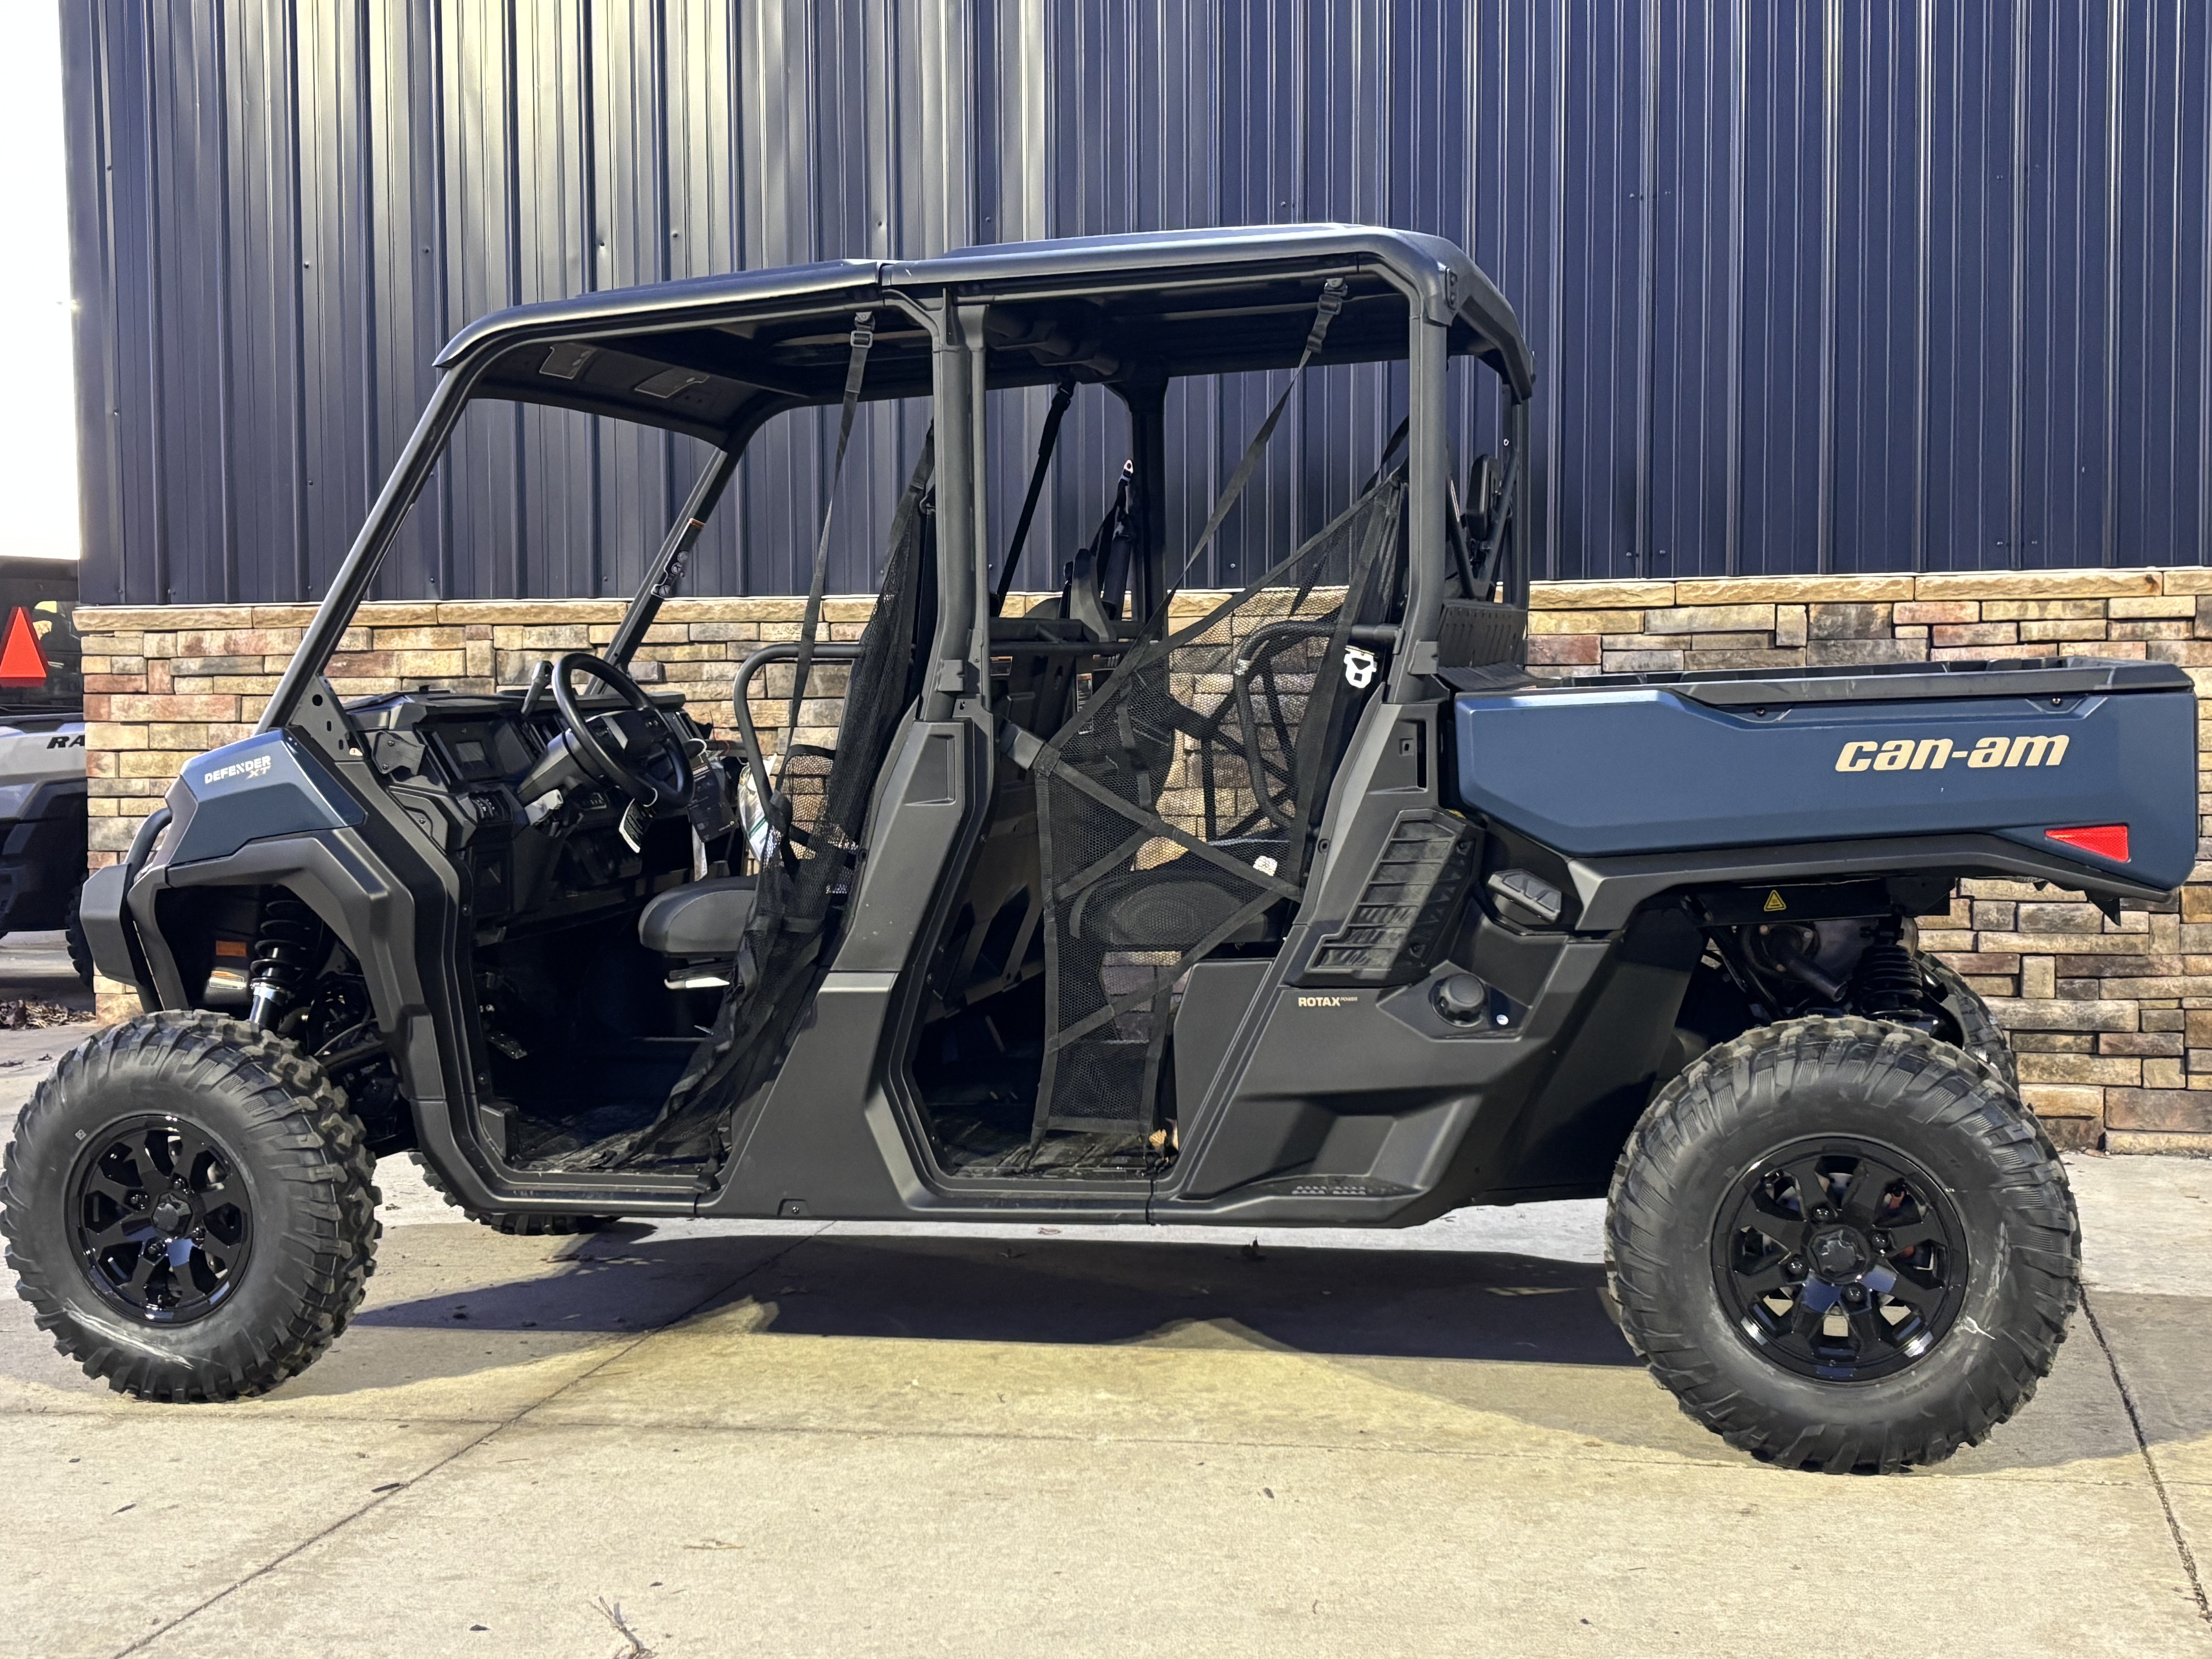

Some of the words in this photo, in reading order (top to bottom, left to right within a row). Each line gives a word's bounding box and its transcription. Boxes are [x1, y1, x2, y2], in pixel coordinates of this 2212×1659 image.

[46, 735, 85, 749] RA
[1835, 735, 2069, 772] can-am
[204, 755, 271, 784] DEFENDER
[245, 765, 271, 780] XT
[1298, 997, 1340, 1007] ROTAX
